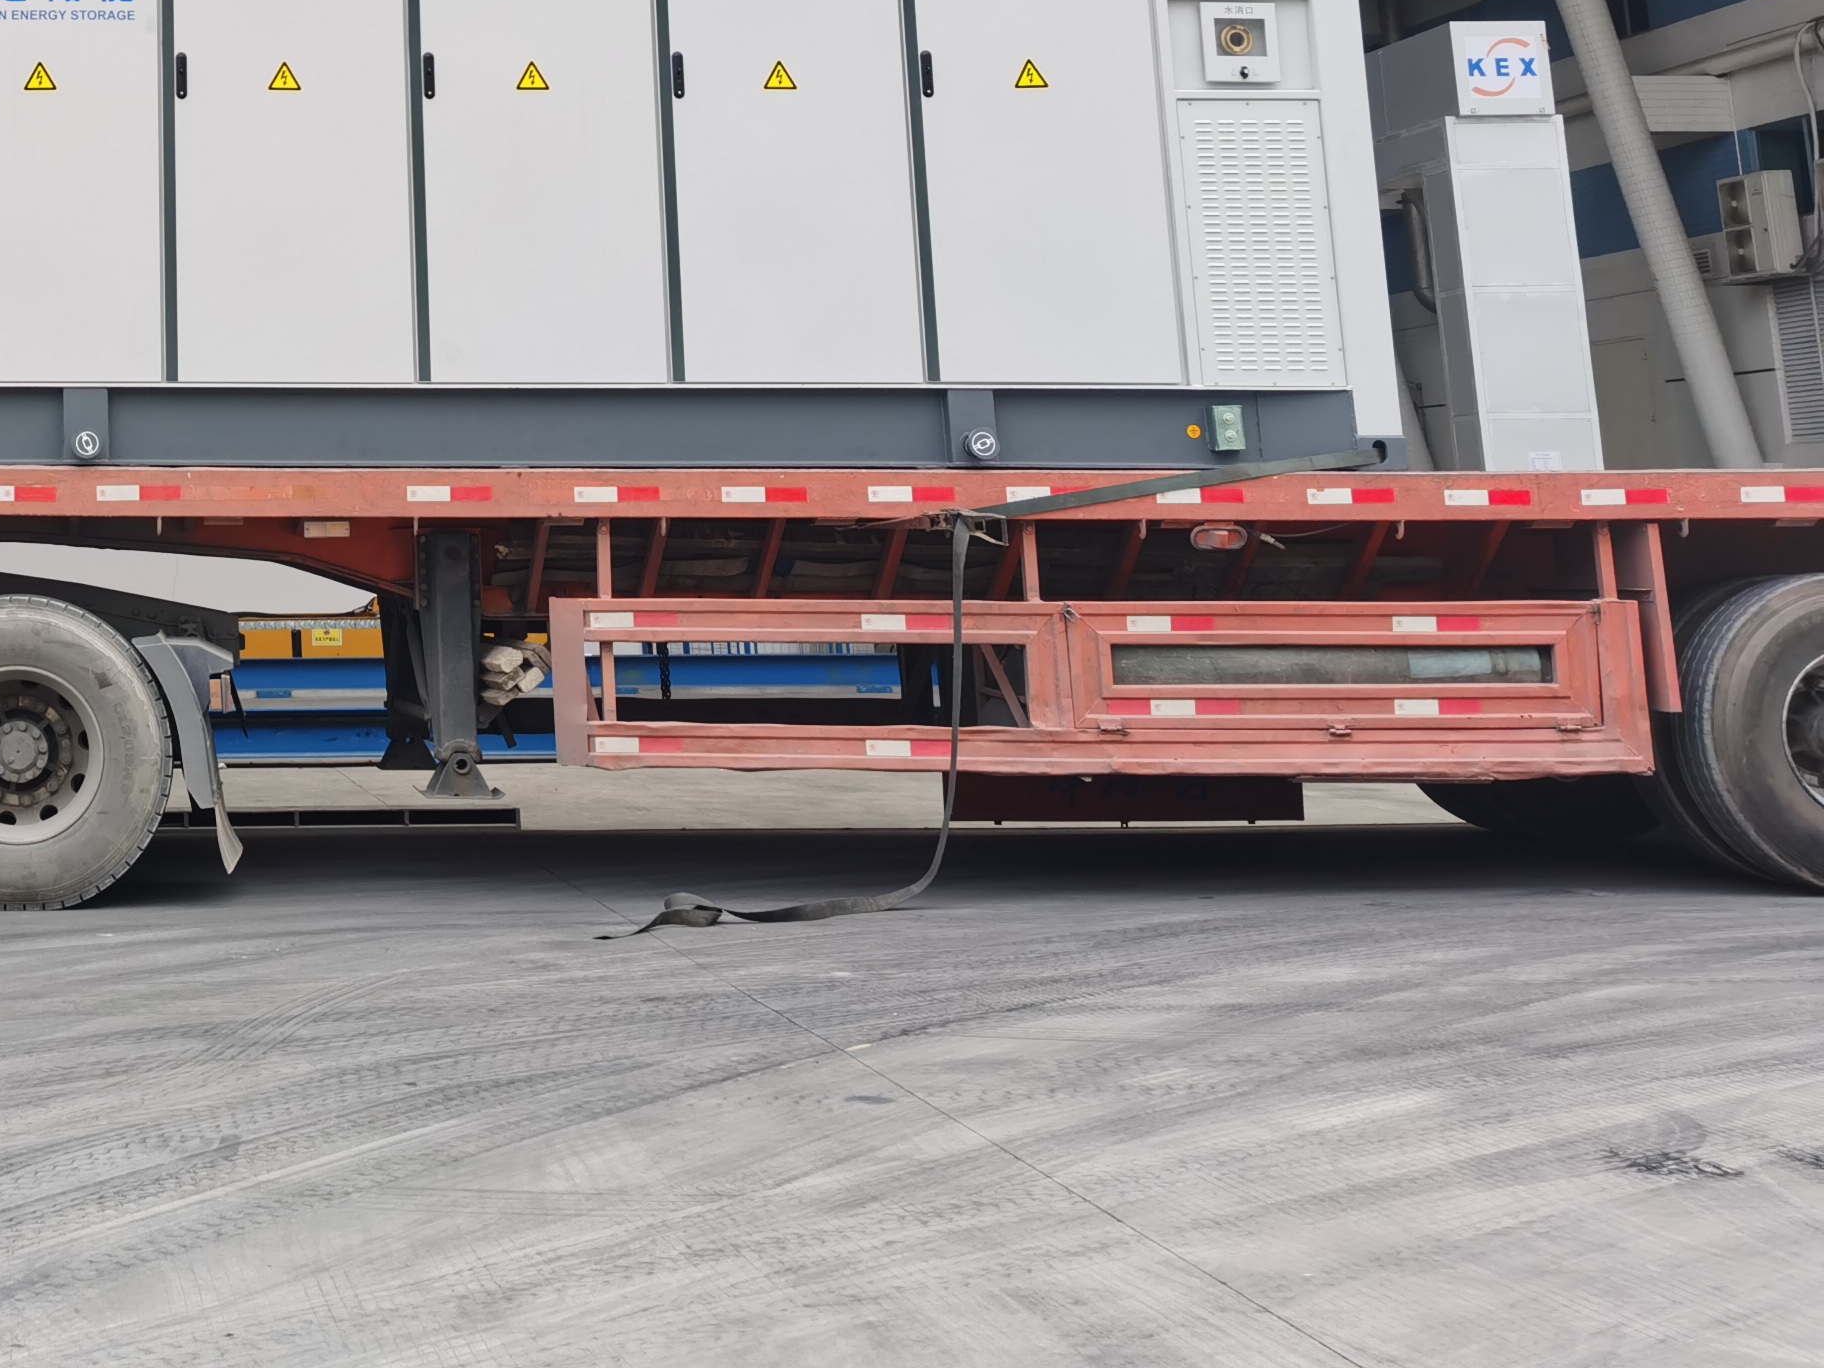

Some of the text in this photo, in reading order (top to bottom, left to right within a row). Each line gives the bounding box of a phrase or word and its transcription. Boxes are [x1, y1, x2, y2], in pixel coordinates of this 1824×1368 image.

[11, 10, 67, 20] ENERGY
[70, 10, 136, 20] STORAGE
[1467, 57, 1538, 77] KEX
